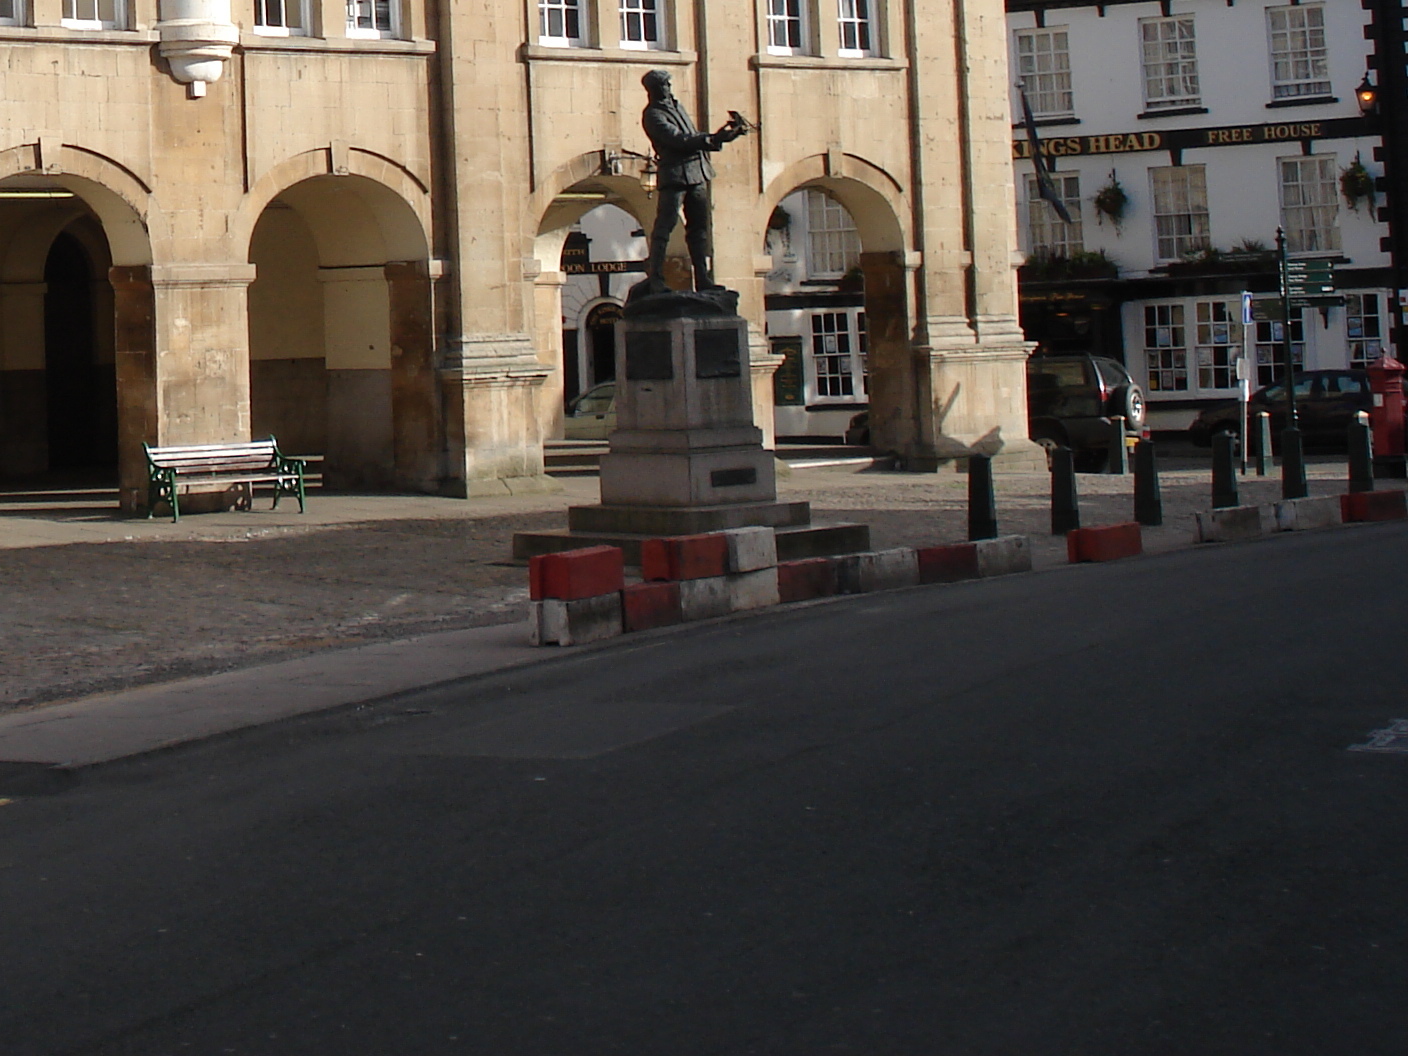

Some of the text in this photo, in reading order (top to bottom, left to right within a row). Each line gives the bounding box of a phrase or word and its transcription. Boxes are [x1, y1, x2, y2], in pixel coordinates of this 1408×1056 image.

[1089, 132, 1161, 154] HEAD
[1208, 123, 1321, 143] FREE HOUSE
[592, 262, 627, 272] LODGE
